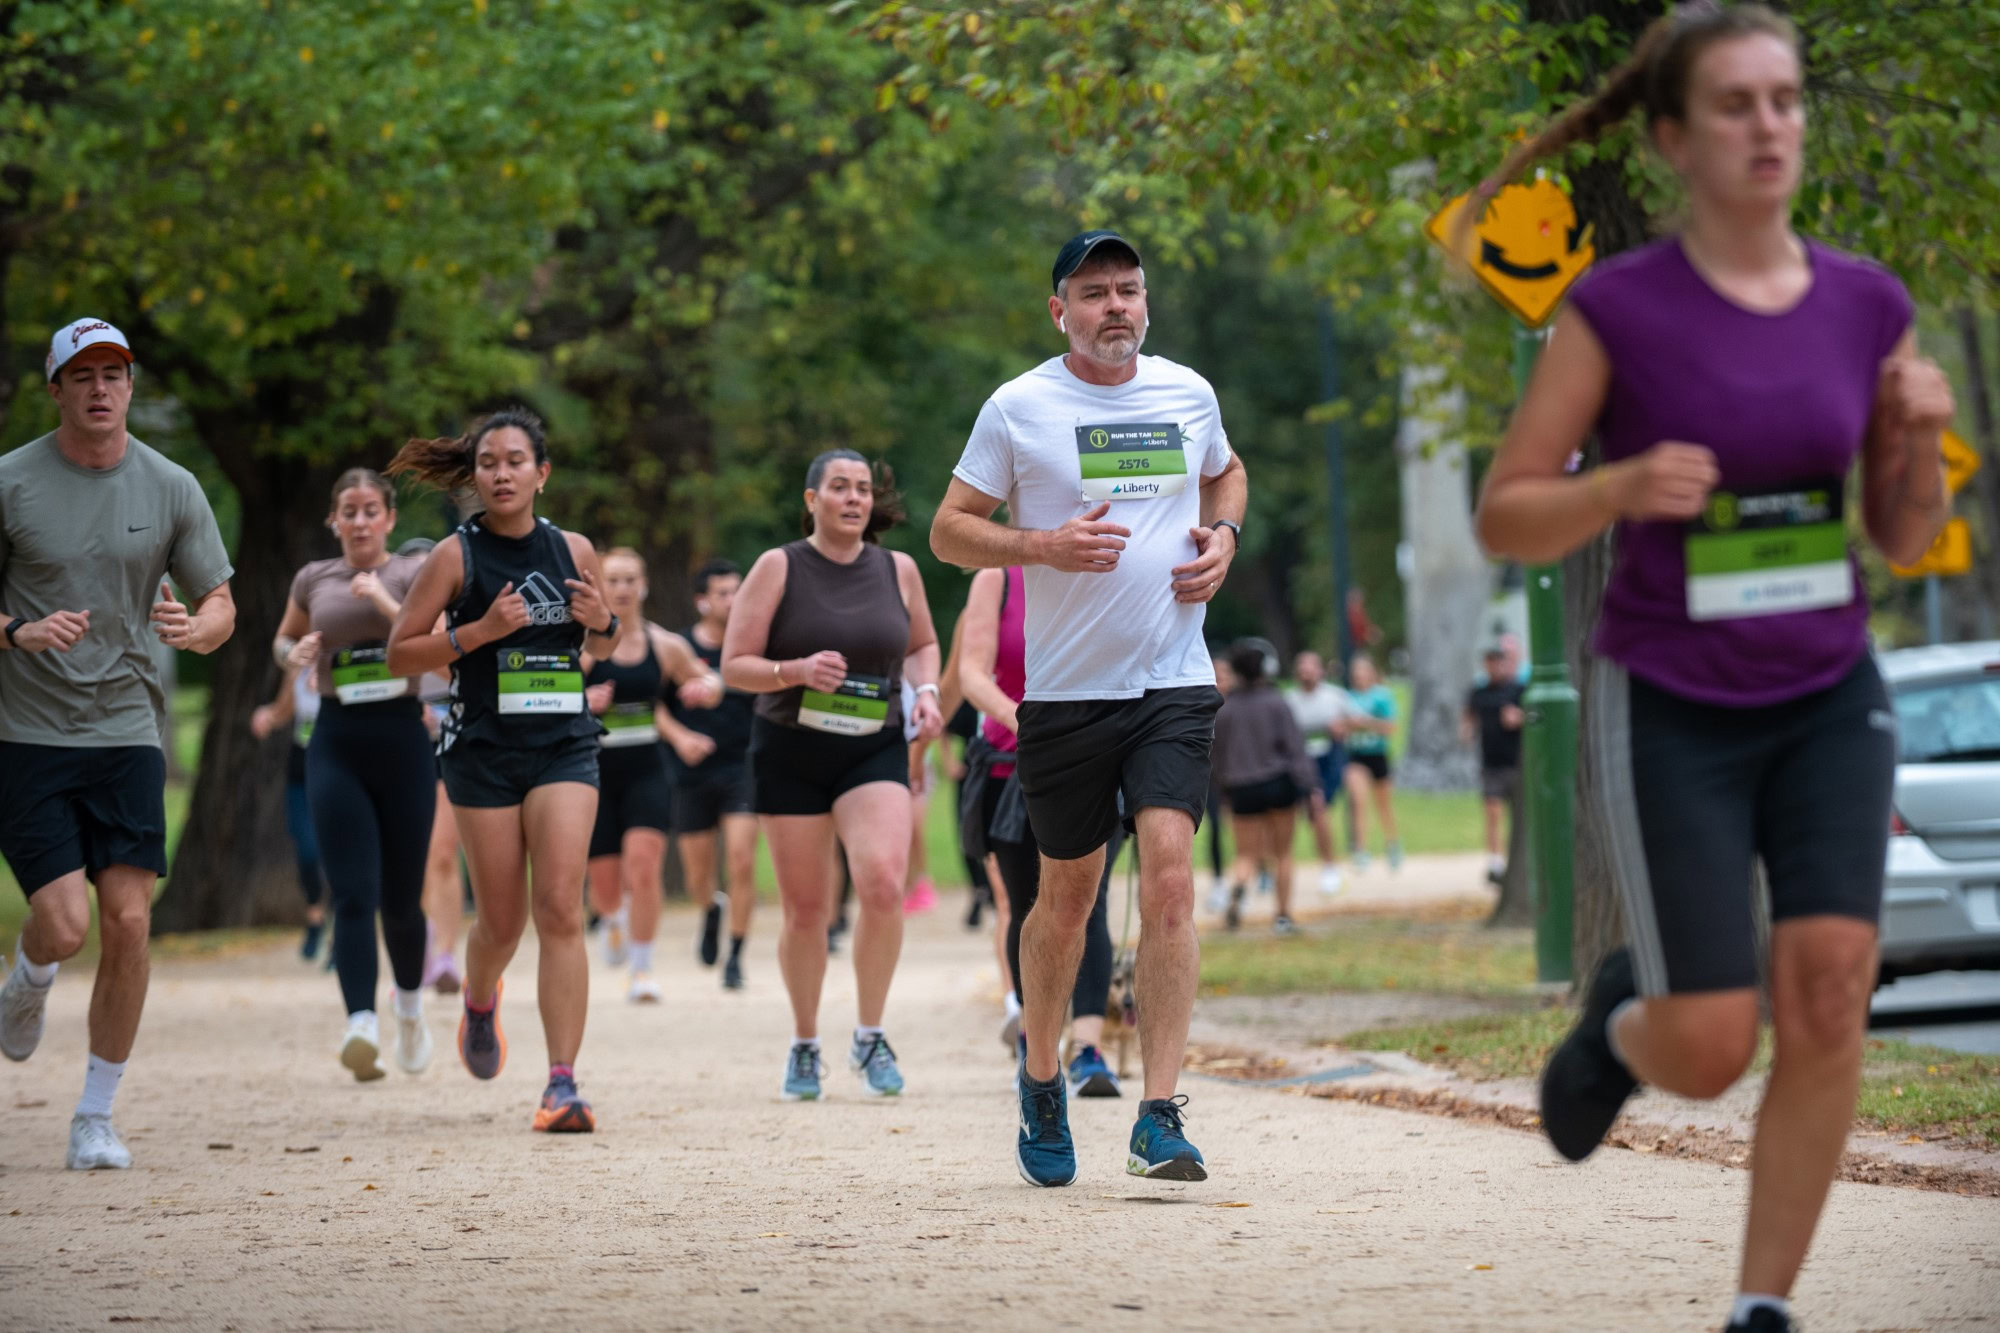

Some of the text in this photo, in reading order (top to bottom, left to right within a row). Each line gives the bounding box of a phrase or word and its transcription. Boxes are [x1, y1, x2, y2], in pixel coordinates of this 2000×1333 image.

[1111, 432, 1125, 440] RUN
[1148, 439, 1168, 447] Liberty
[1118, 458, 1150, 470] 2576
[1123, 482, 1160, 494] Liberty
[533, 698, 562, 709] Liberty
